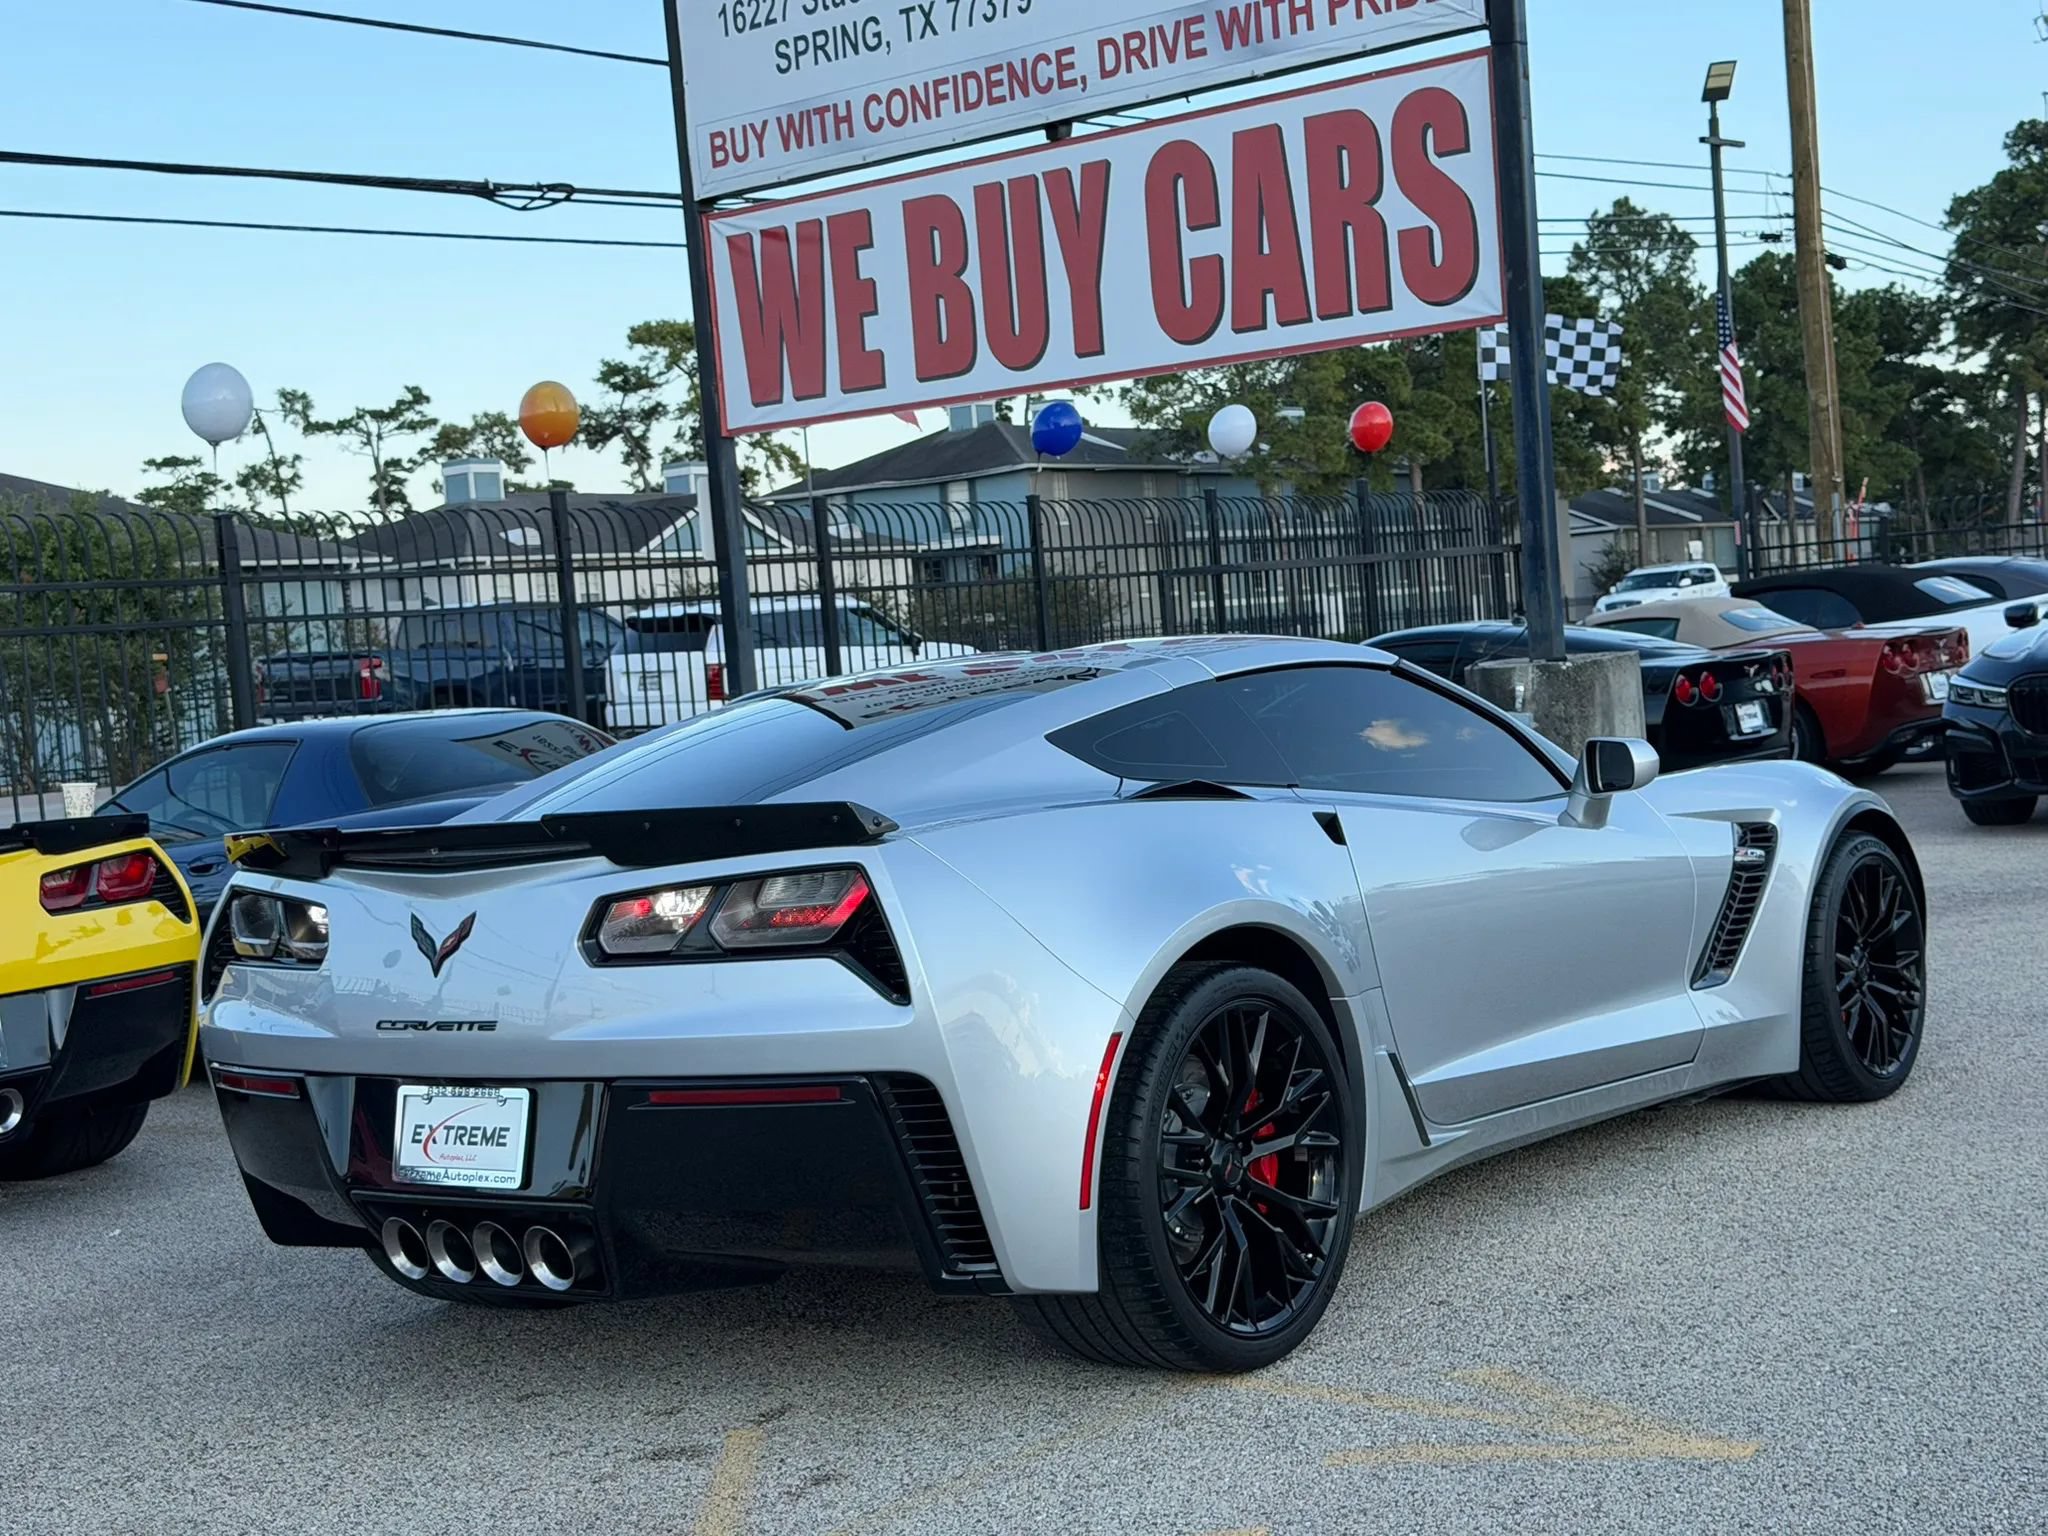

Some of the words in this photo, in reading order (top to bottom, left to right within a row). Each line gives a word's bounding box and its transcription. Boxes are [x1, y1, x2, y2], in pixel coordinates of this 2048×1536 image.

[718, 0, 788, 37] 16227
[774, 16, 892, 75] SPRING,
[898, 0, 939, 43] TX
[709, 118, 769, 169] BUY
[776, 99, 855, 153] WITH
[862, 46, 1089, 134] CONFIDENCE,
[1097, 14, 1208, 80] DRIVE
[1215, 0, 1316, 51] WITH
[726, 207, 887, 406] WE
[902, 157, 1112, 382] BUY
[1144, 86, 1480, 345] CARS
[375, 1019, 499, 1031] CORVETTE
[411, 1123, 511, 1148] EXTREME
